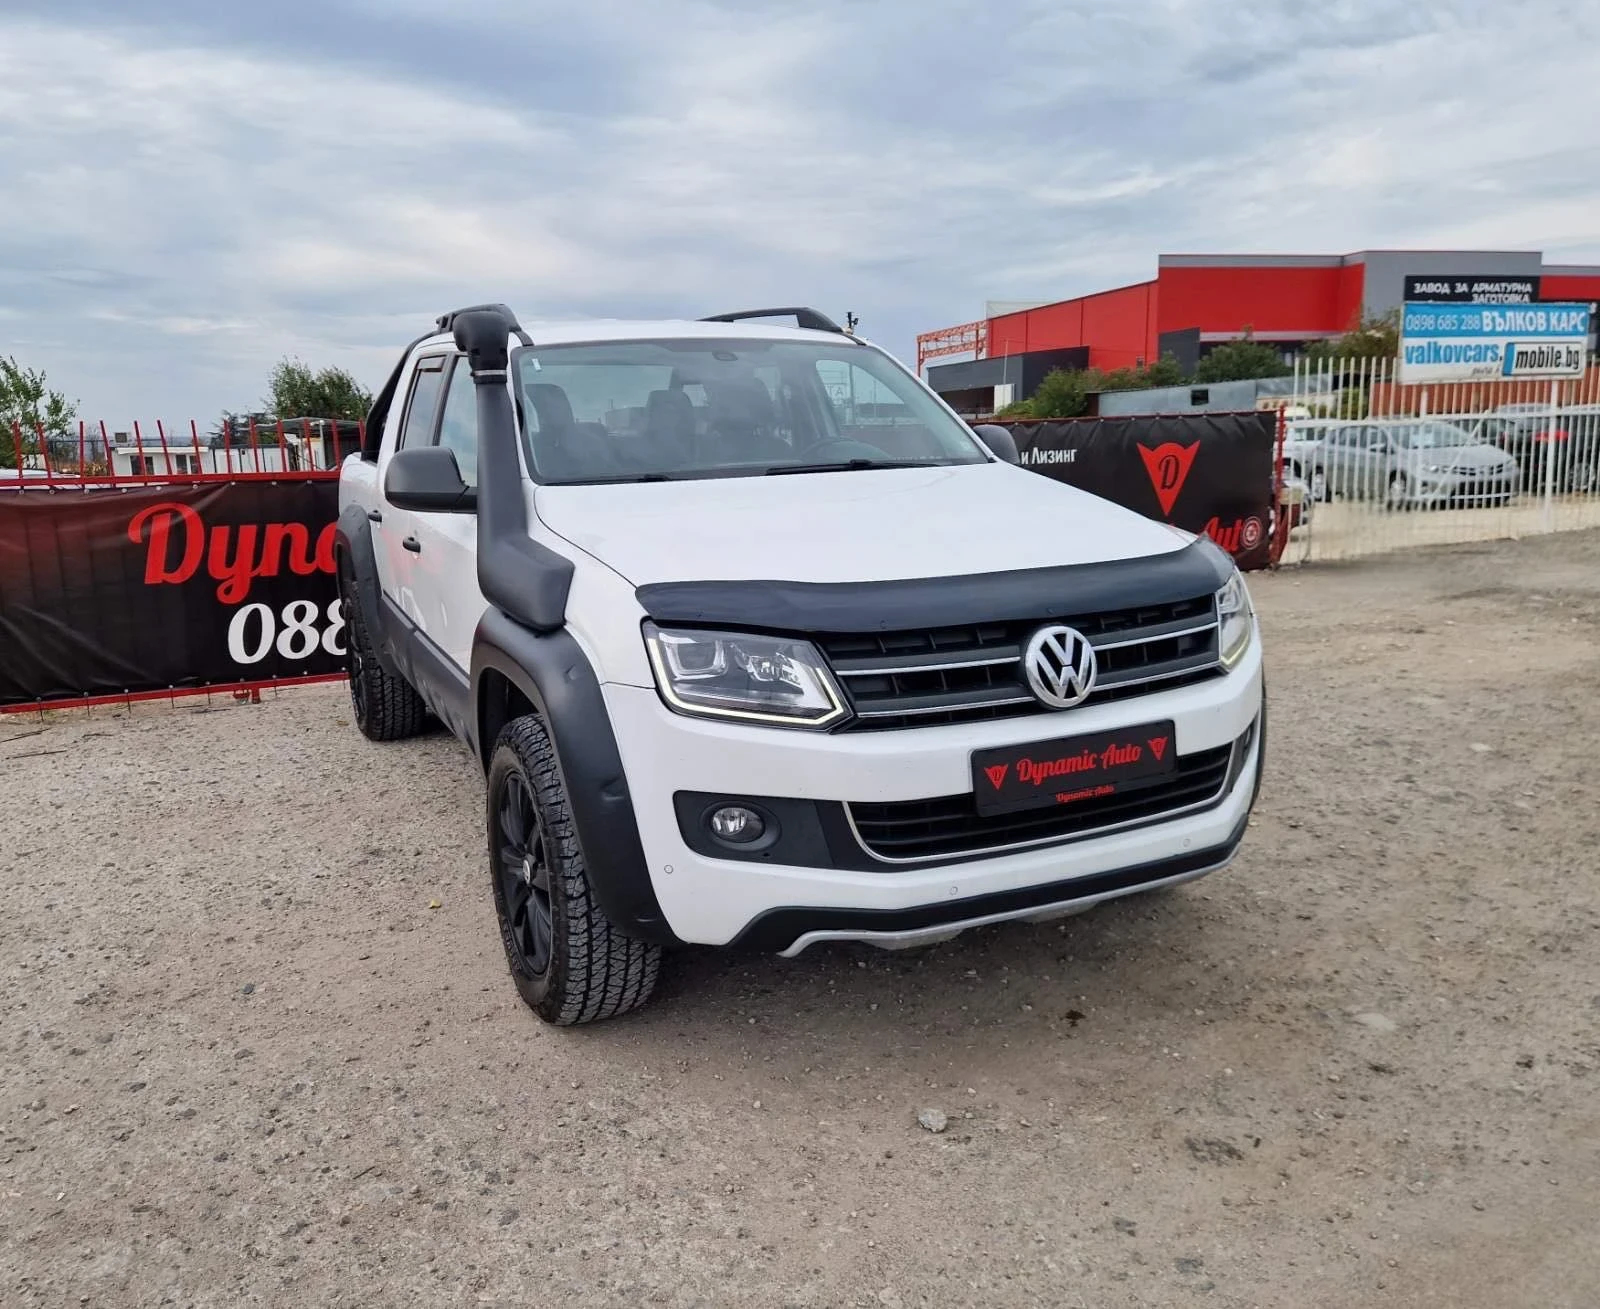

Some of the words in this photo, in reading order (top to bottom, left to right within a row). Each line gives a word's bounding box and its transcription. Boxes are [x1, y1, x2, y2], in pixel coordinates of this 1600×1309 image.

[1413, 282, 1450, 295] ЗАВОД
[1454, 282, 1469, 293] ЗА
[1471, 282, 1533, 294] АРМАТУРНА
[1405, 314, 1436, 331] 0898
[1438, 314, 1457, 331] 685
[1460, 313, 1480, 330] 288
[1481, 311, 1546, 332] ВЪЛКОВ
[1550, 311, 1586, 332] КАРС
[1031, 447, 1077, 465] Лизинг
[1158, 454, 1180, 490] D
[1026, 626, 1097, 707] VW
[1016, 749, 1097, 786] Dynamic
[1099, 744, 1142, 770] Auto
[1055, 788, 1094, 804] Dynamic
[1094, 784, 1115, 796] Auto
